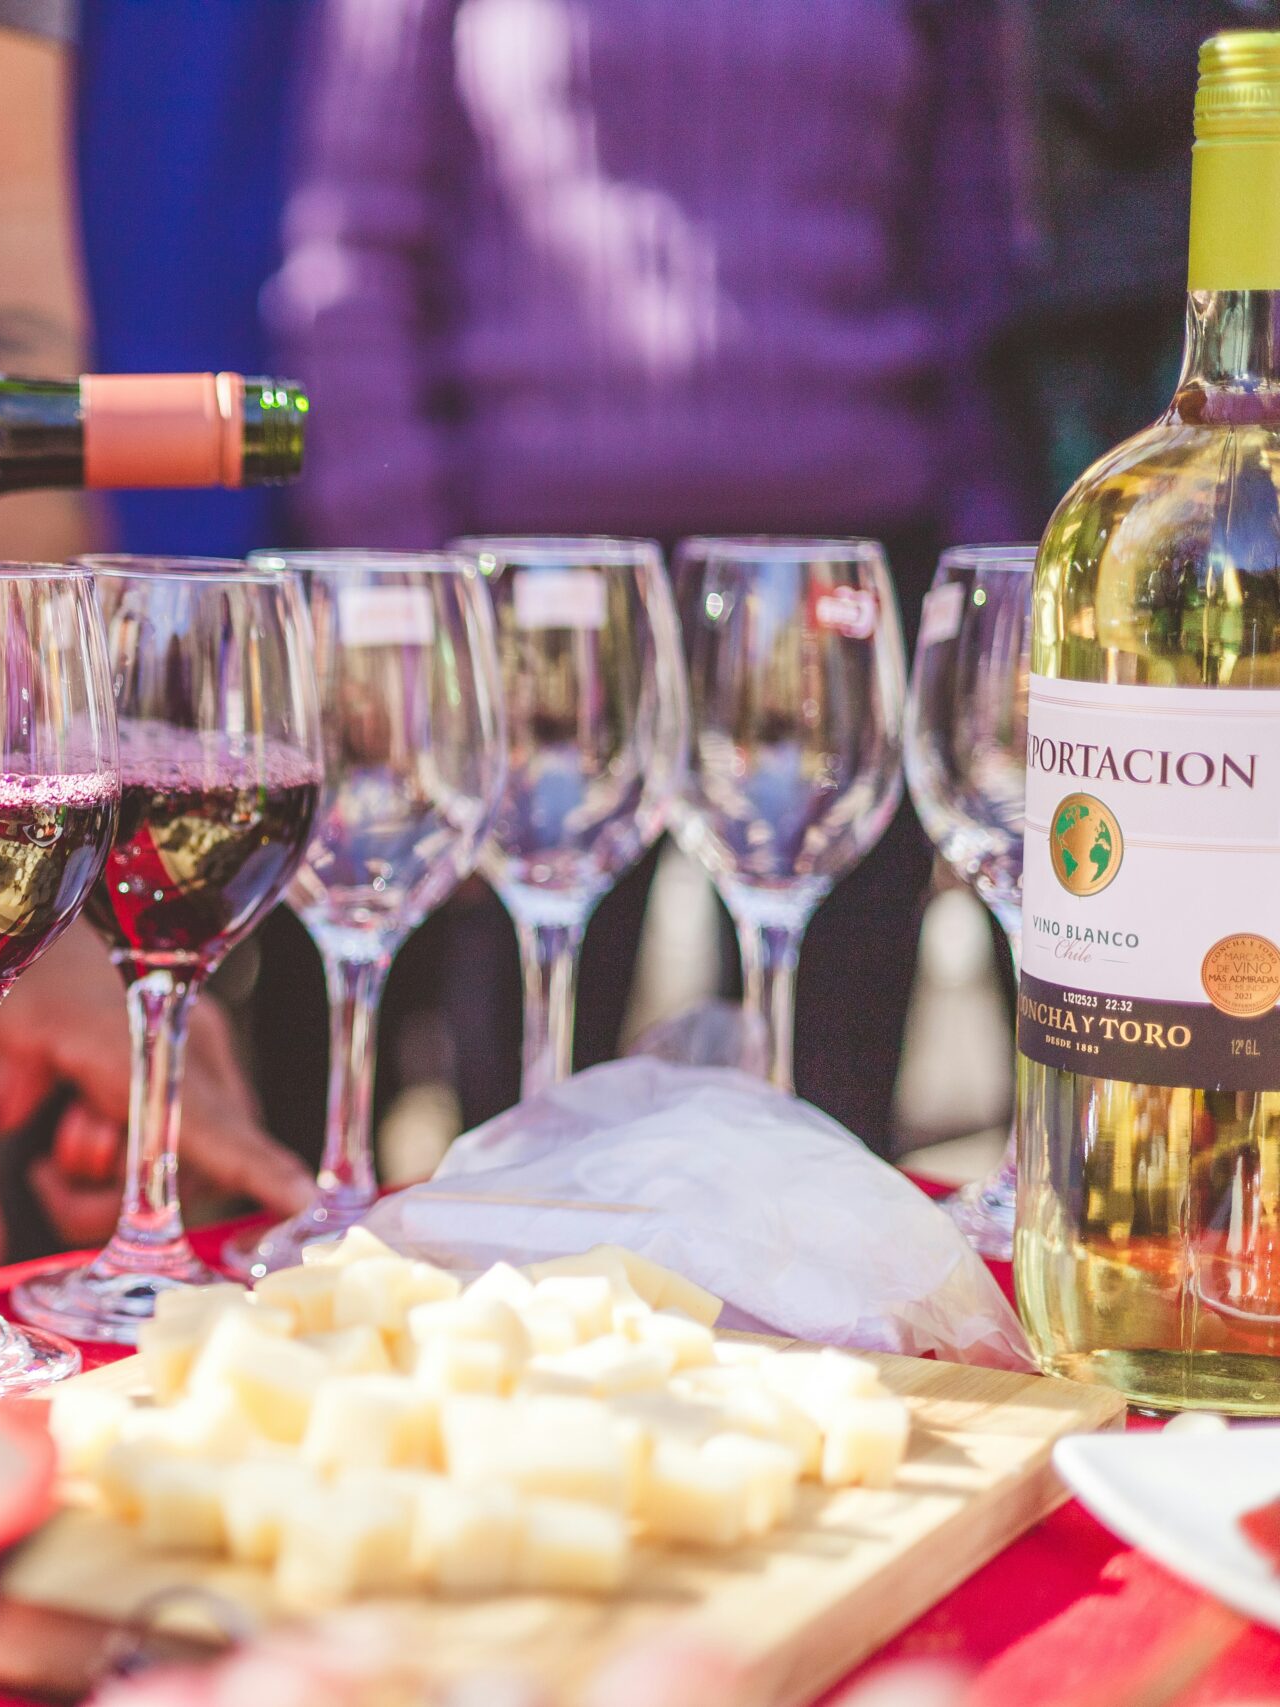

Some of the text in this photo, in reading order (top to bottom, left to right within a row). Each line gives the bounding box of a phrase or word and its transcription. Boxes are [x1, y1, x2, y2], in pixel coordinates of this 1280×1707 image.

[1033, 915, 1139, 948] VINO BLANCO
[1054, 937, 1092, 963] Chile
[1211, 940, 1245, 964] CONCHA
[1259, 944, 1278, 964] TORO
[1224, 953, 1265, 961] MARCAS
[1216, 962, 1272, 974] DE VINO
[1217, 983, 1232, 991] DEL
[1229, 975, 1279, 984] ADMIRADAS
[1063, 992, 1133, 1012] L1212523 22:32
[1234, 992, 1252, 1000] 2021
[1081, 1015, 1095, 1034] Y
[1099, 1017, 1192, 1049] TORO
[1045, 1034, 1100, 1055] DESDE 1883
